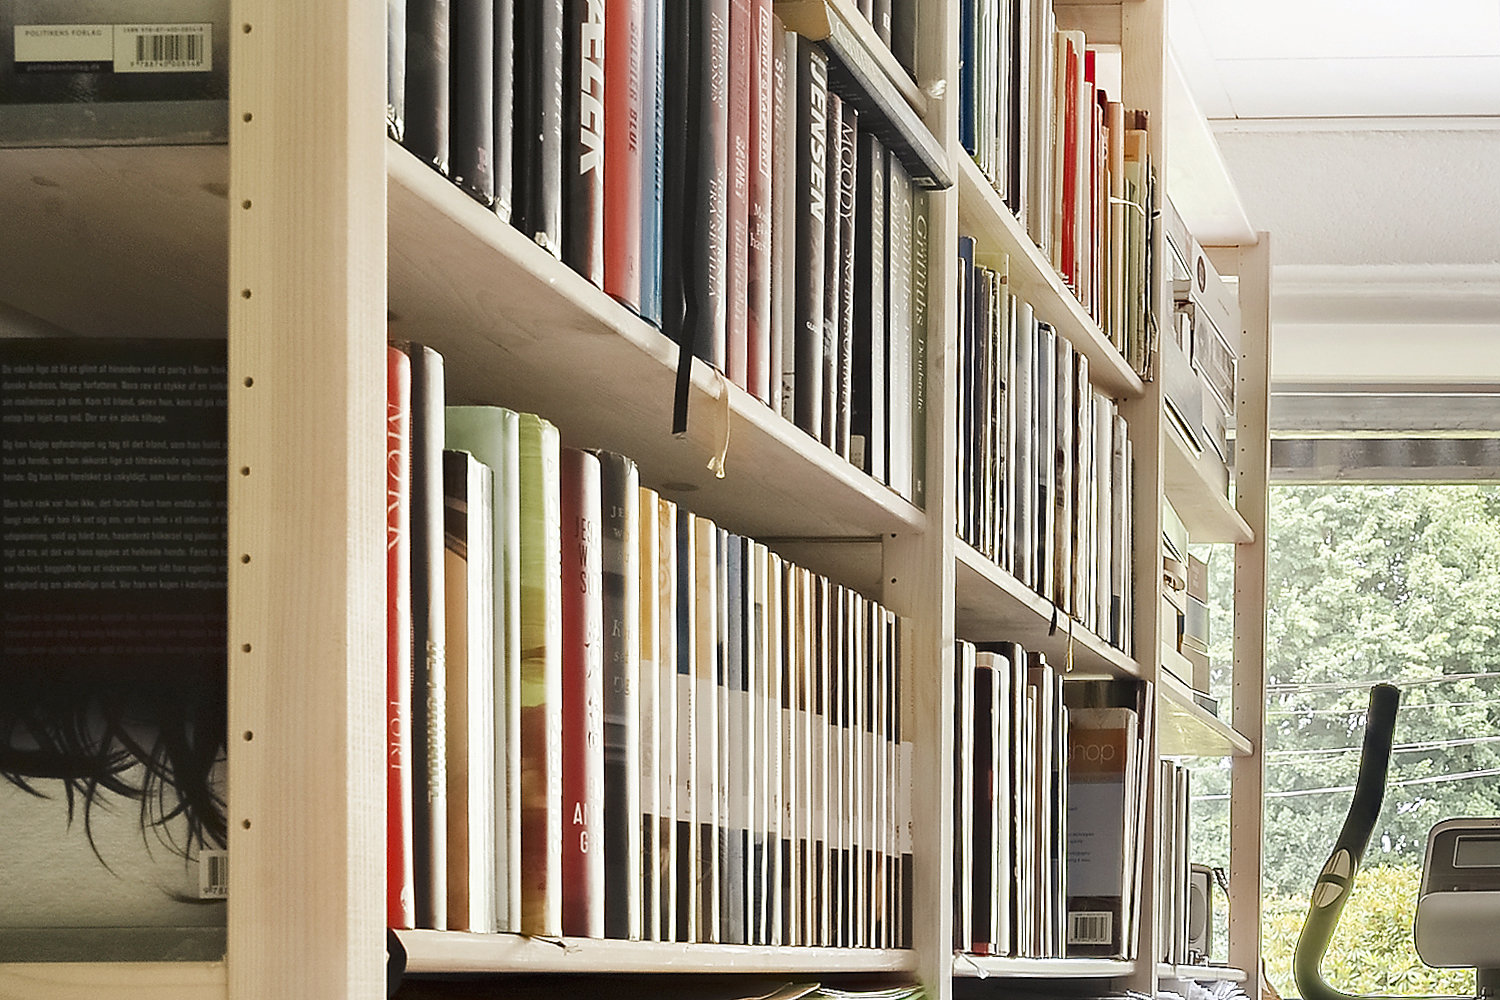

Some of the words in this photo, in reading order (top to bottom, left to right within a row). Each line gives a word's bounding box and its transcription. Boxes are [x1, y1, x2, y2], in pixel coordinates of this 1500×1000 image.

[710, 12, 718, 103] FALCONES
[629, 109, 637, 155] BLUE
[735, 135, 745, 203] SAVNET
[809, 64, 826, 221] JENSEN
[709, 179, 717, 215] FRA
[839, 122, 855, 228] MOODY
[708, 219, 717, 298] SEVILLA
[914, 214, 928, 327] Griffiths
[917, 337, 925, 354] De
